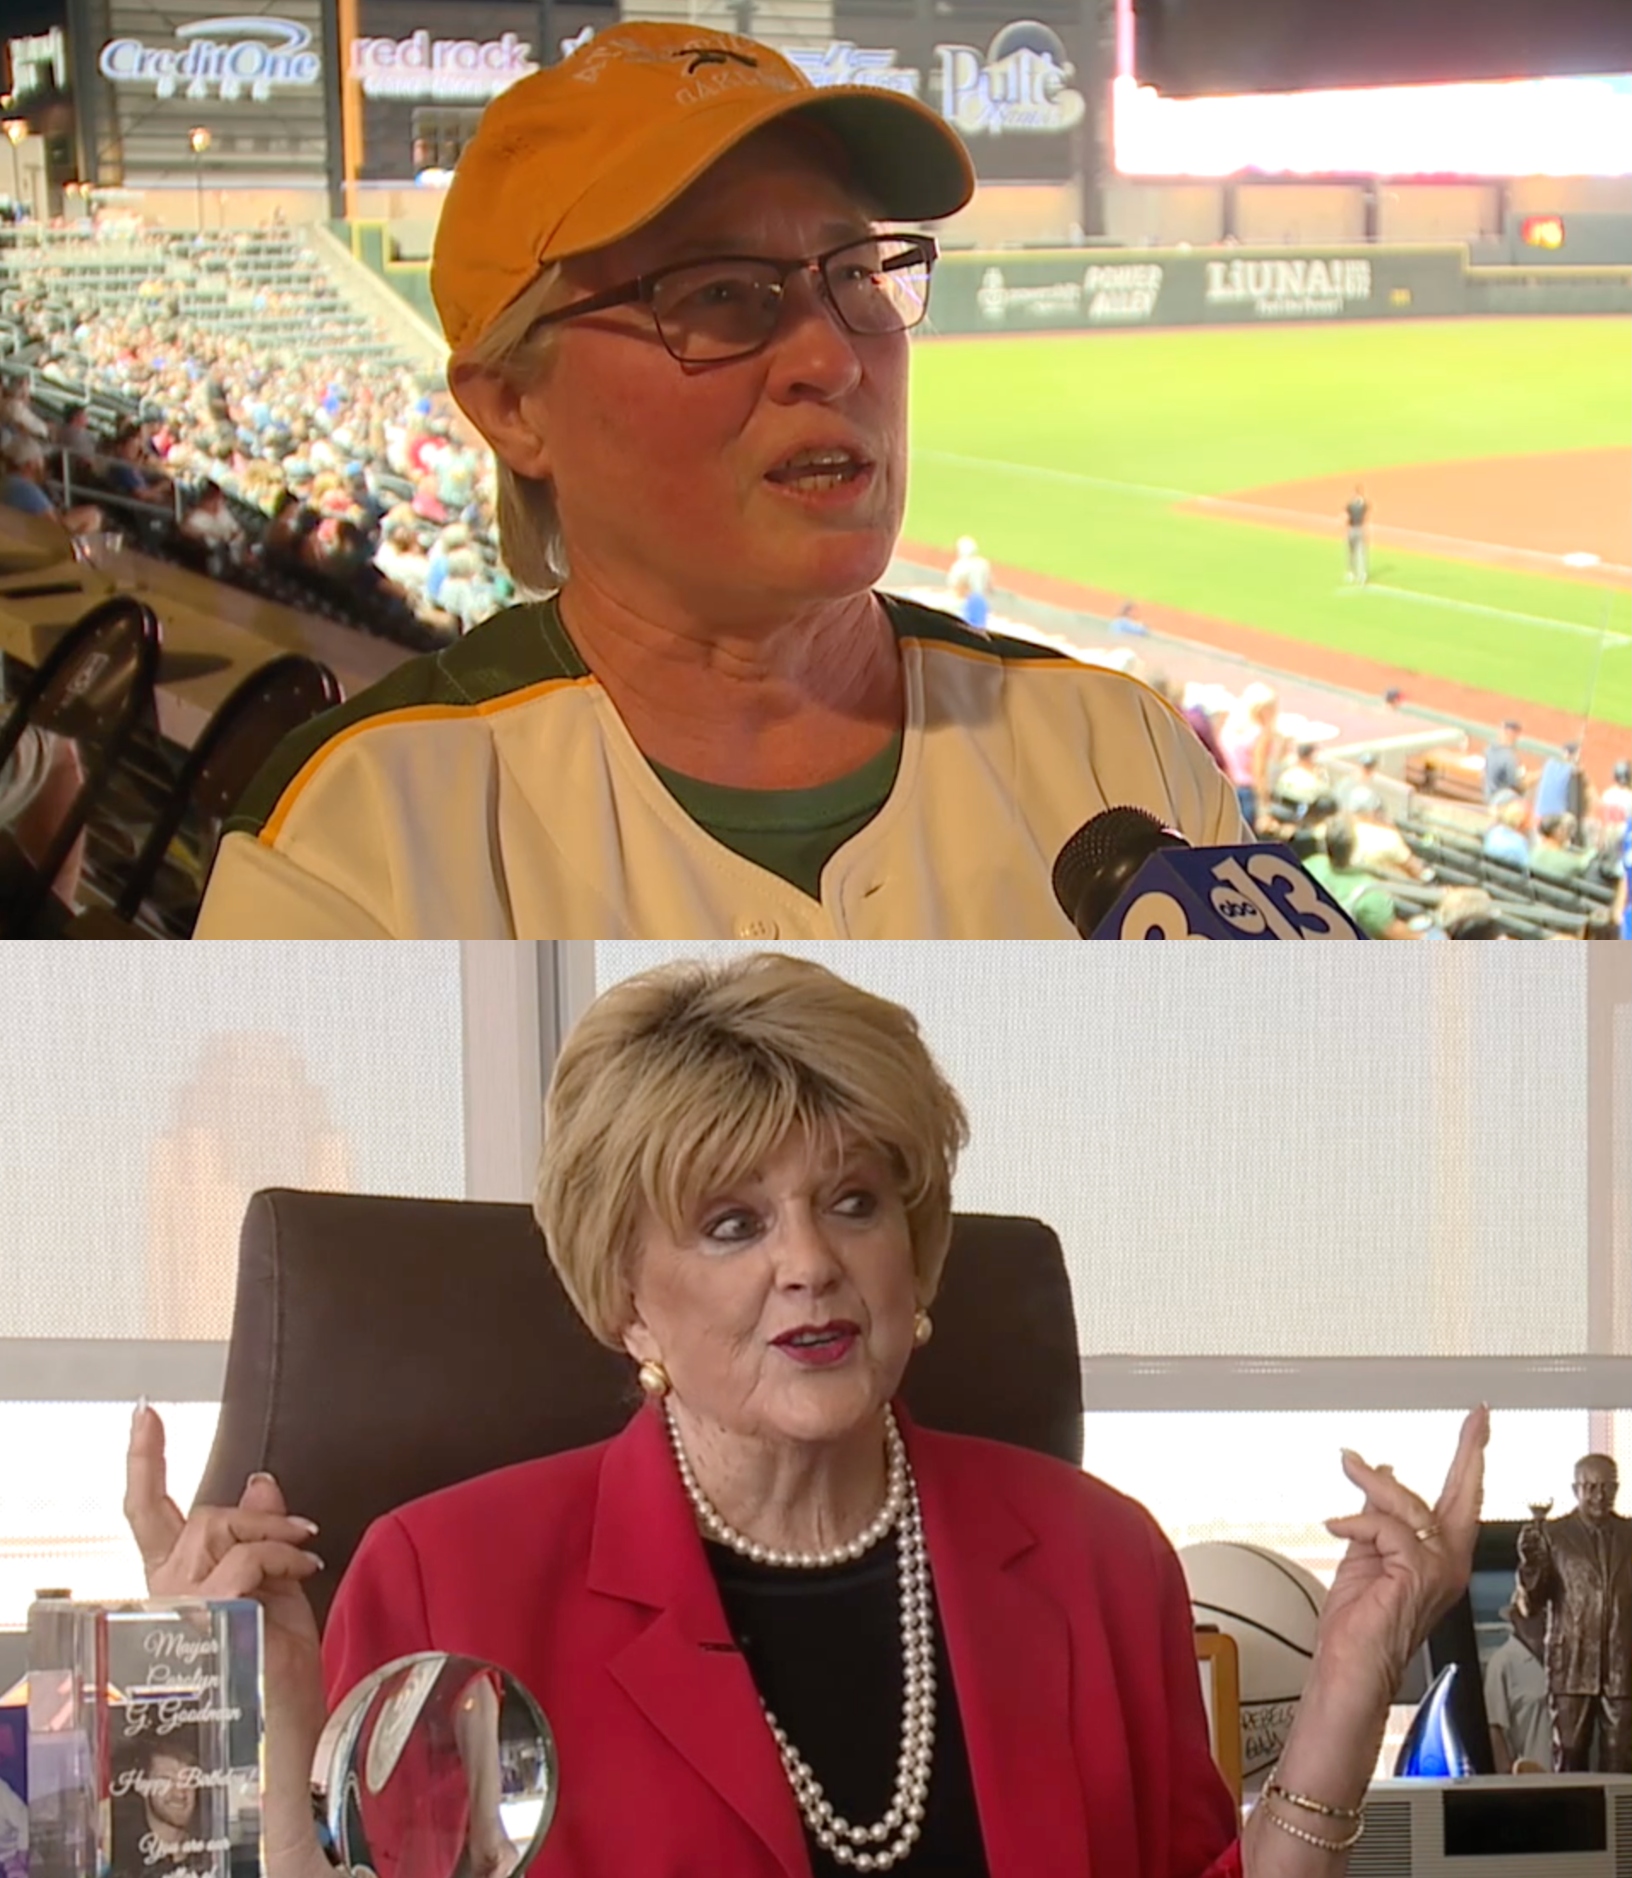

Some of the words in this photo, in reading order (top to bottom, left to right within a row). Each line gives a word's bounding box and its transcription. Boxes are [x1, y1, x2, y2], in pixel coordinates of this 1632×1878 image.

[350, 29, 430, 72] red
[432, 32, 539, 74] rock
[934, 44, 1066, 126] Pulte
[1211, 854, 1359, 940] 13
[1218, 899, 1257, 919] abc
[143, 1629, 219, 1664] Mayor
[146, 1663, 219, 1699] Carolyn
[124, 1700, 152, 1737] G.
[156, 1697, 241, 1735] Goodman
[109, 1768, 172, 1797] Happy
[138, 1831, 179, 1865] You
[181, 1837, 205, 1854] are
